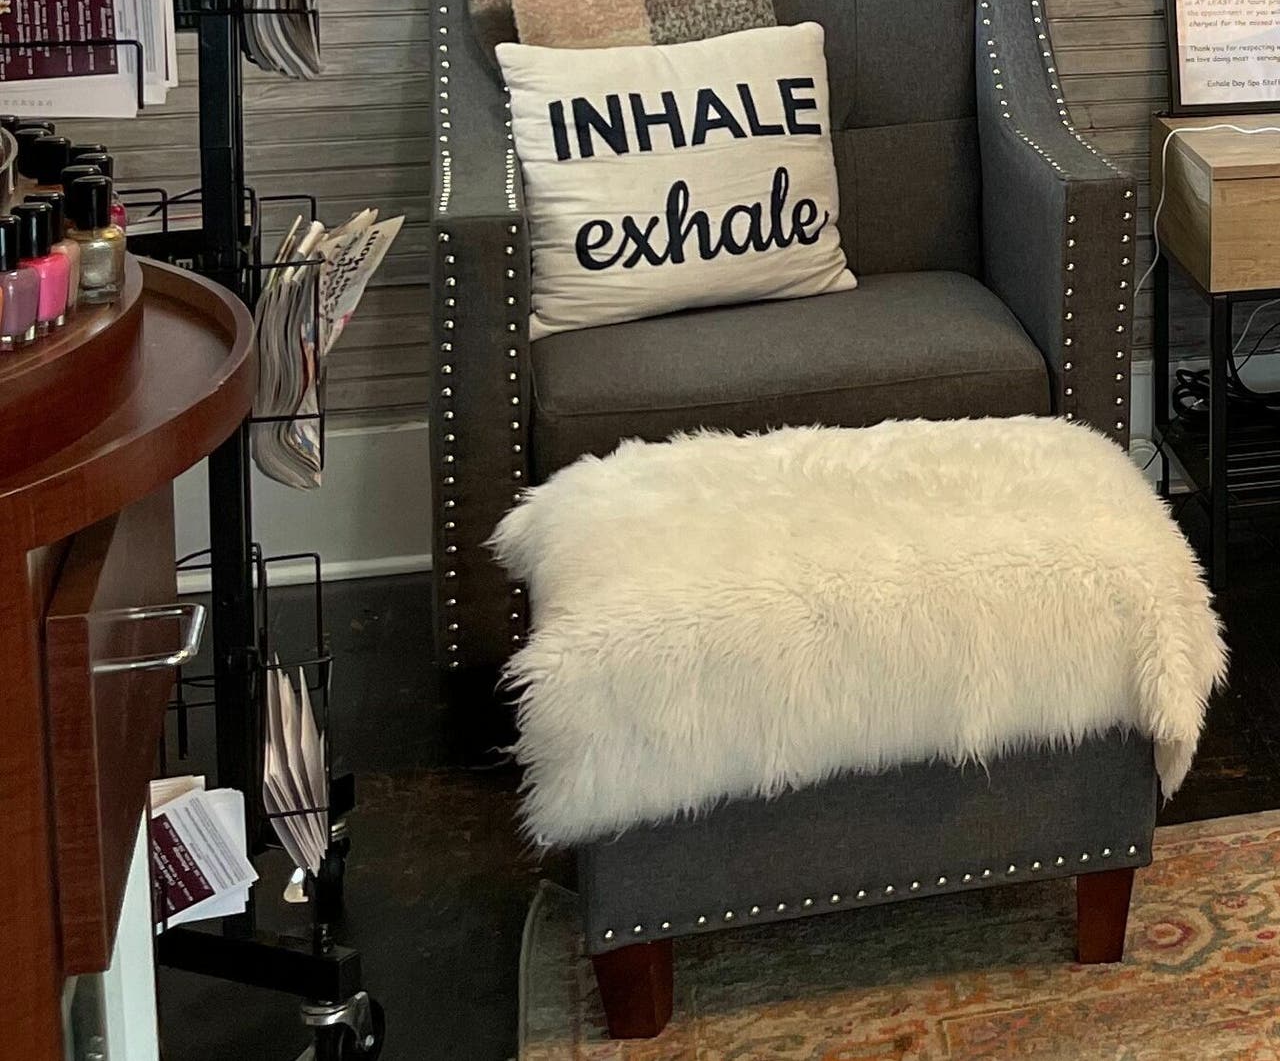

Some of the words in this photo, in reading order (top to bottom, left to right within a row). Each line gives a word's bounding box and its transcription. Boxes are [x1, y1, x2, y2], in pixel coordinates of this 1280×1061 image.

[1189, 19, 1218, 27] charged
[1190, 44, 1210, 52] Thank
[1239, 44, 1275, 52] respecting
[1232, 80, 1246, 88] Day
[548, 77, 822, 161] INHALE
[574, 166, 831, 271] exhale
